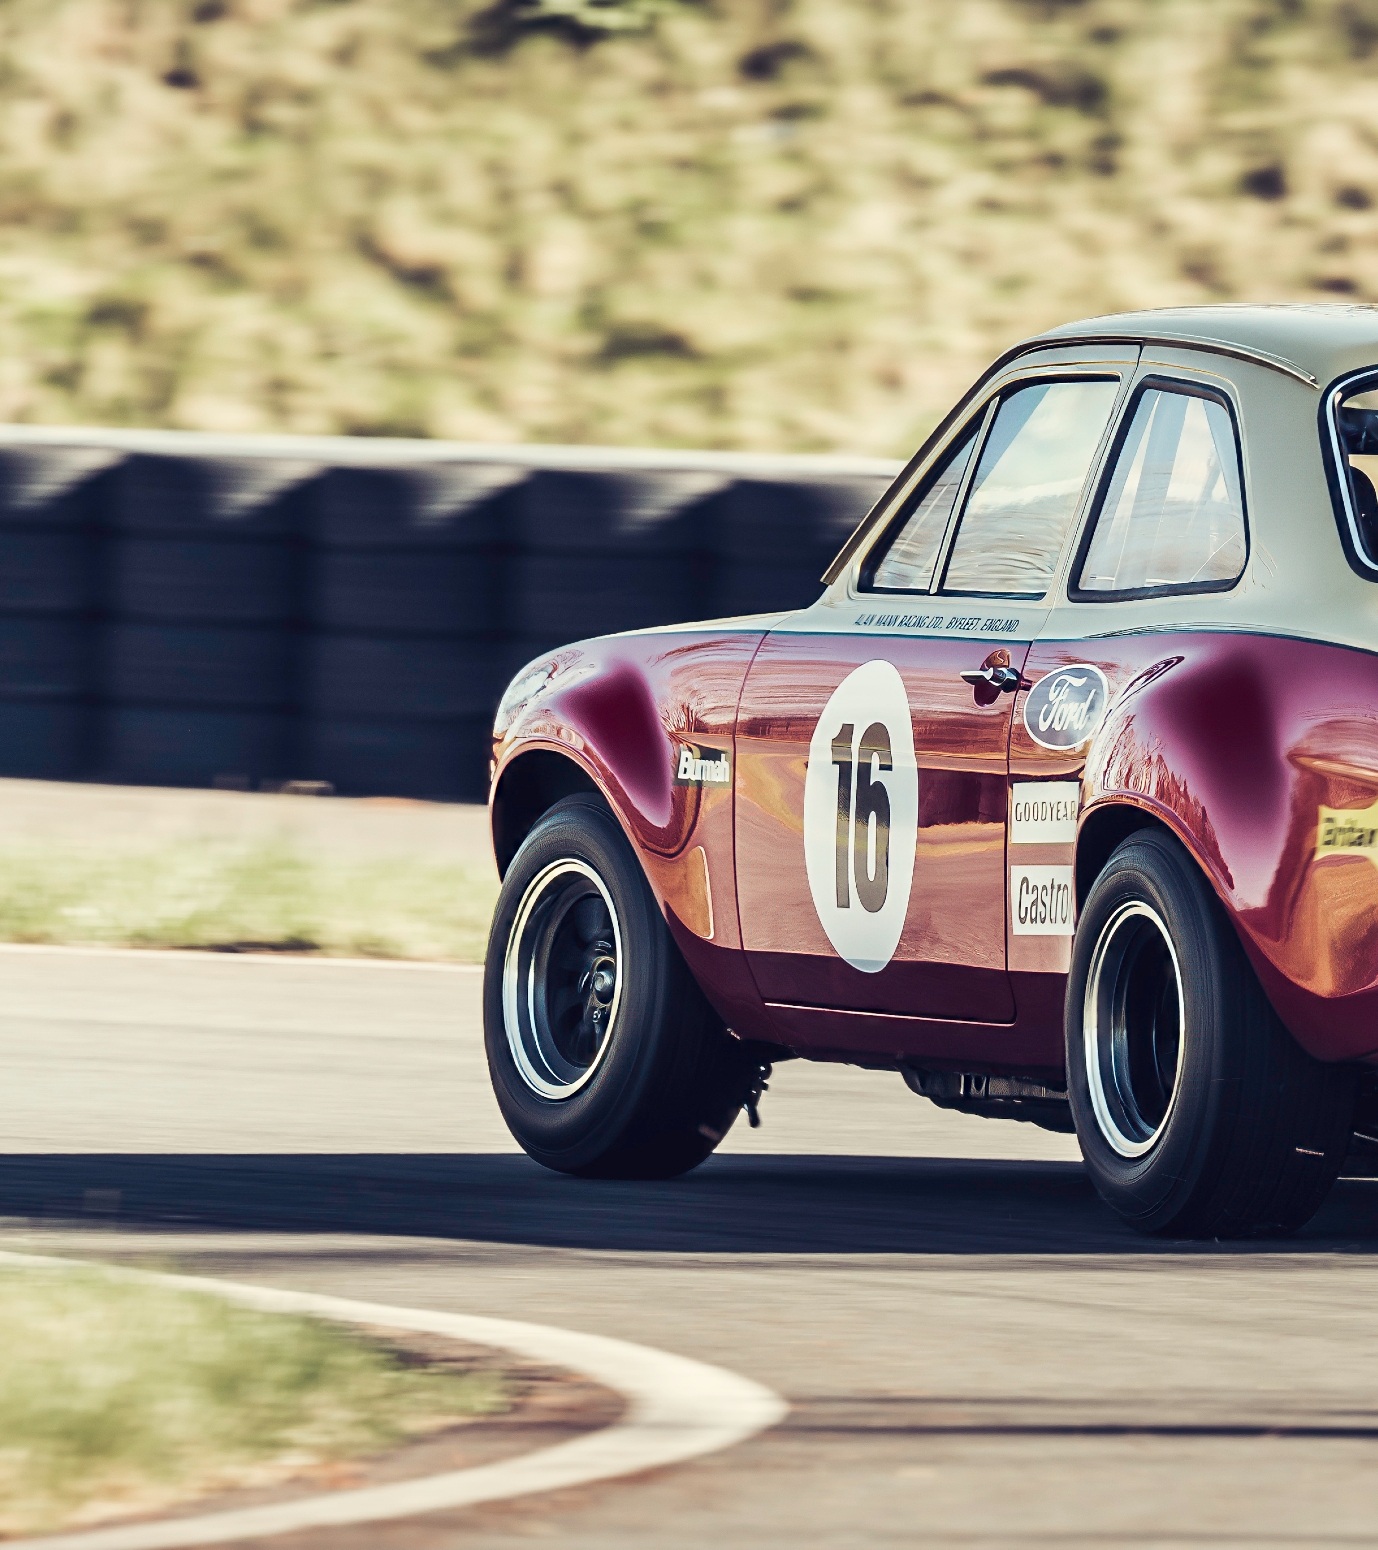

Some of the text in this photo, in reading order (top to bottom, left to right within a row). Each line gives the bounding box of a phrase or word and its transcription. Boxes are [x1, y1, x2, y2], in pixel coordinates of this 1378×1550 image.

[854, 613, 878, 627] ALAN
[875, 614, 900, 627] MANN
[897, 615, 930, 629] RACING
[1038, 674, 1097, 732] Ford
[677, 750, 730, 783] Burmah
[831, 721, 893, 914] 16
[1014, 800, 1077, 823] GOODYEAR
